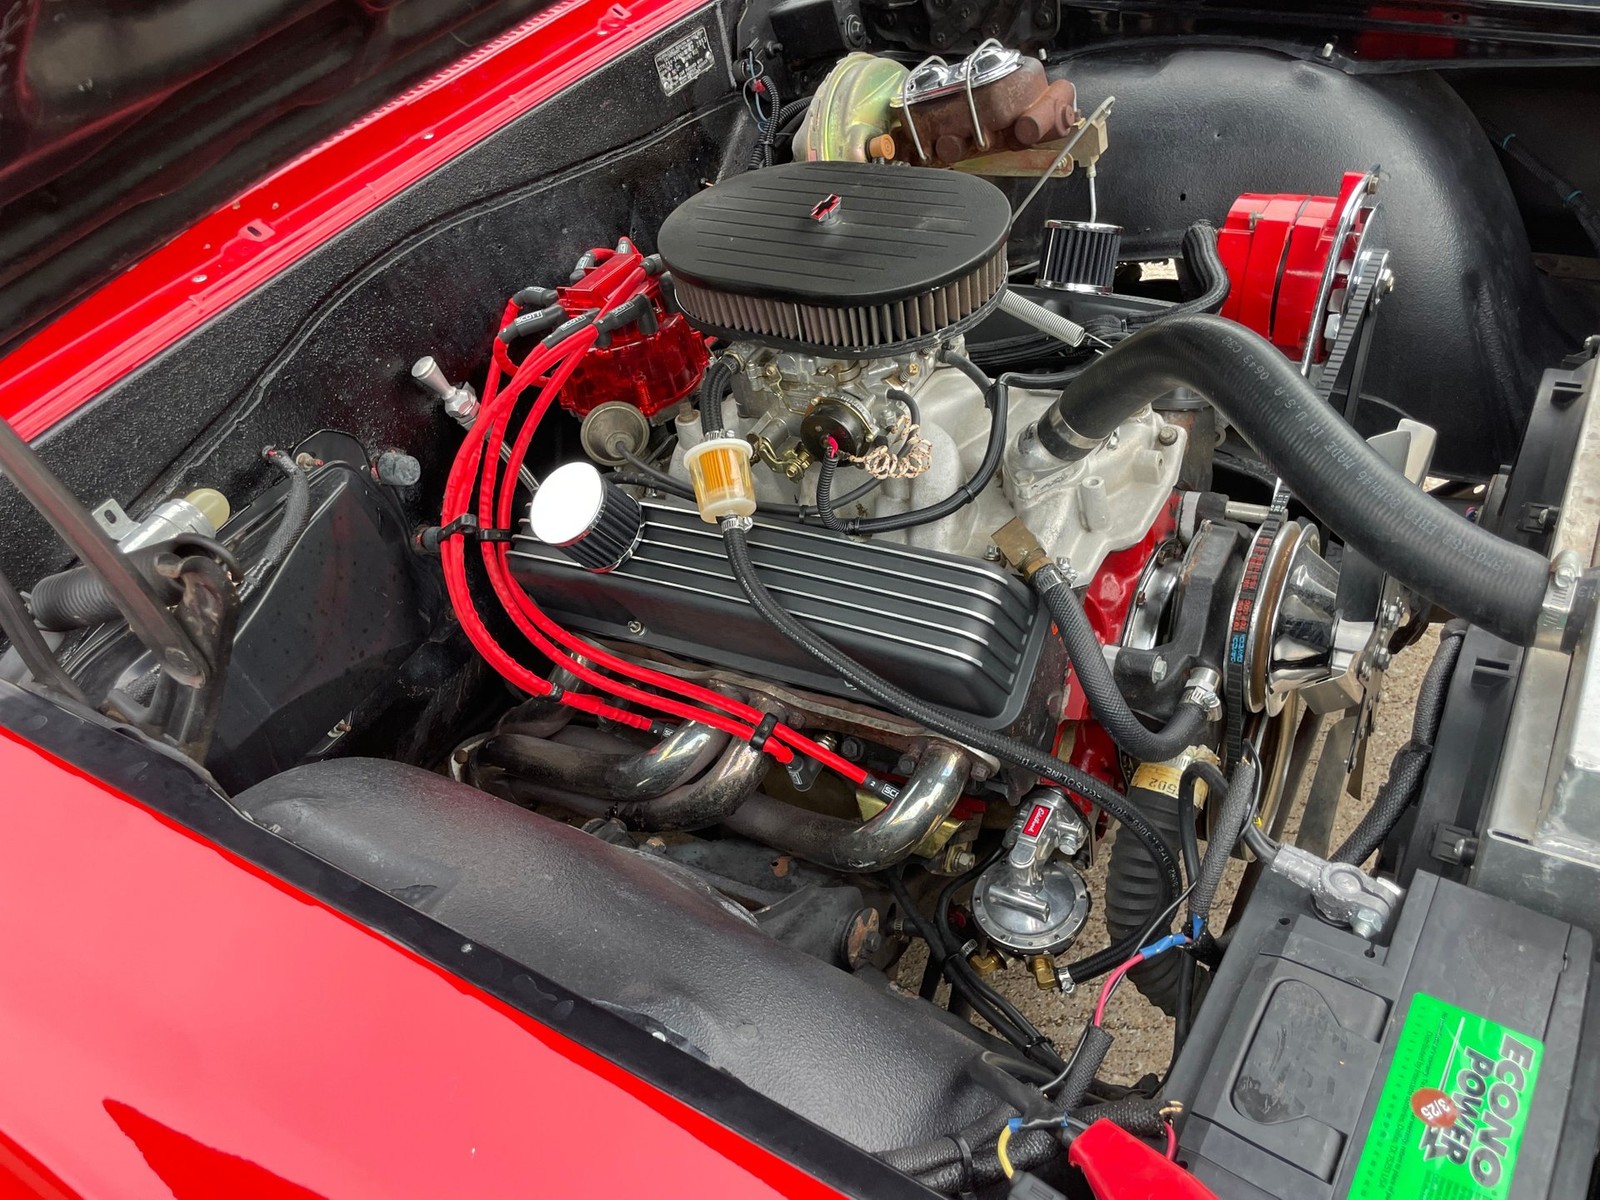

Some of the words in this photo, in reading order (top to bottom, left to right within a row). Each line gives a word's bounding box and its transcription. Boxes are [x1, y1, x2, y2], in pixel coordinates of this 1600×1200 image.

[515, 310, 542, 324] SCOTT
[1306, 421, 1324, 440] IN
[1325, 439, 1357, 471] MADE
[1420, 1098, 1450, 1121] 3/25
[1441, 1046, 1495, 1166] POWER
[1469, 1033, 1536, 1188] ECONO
